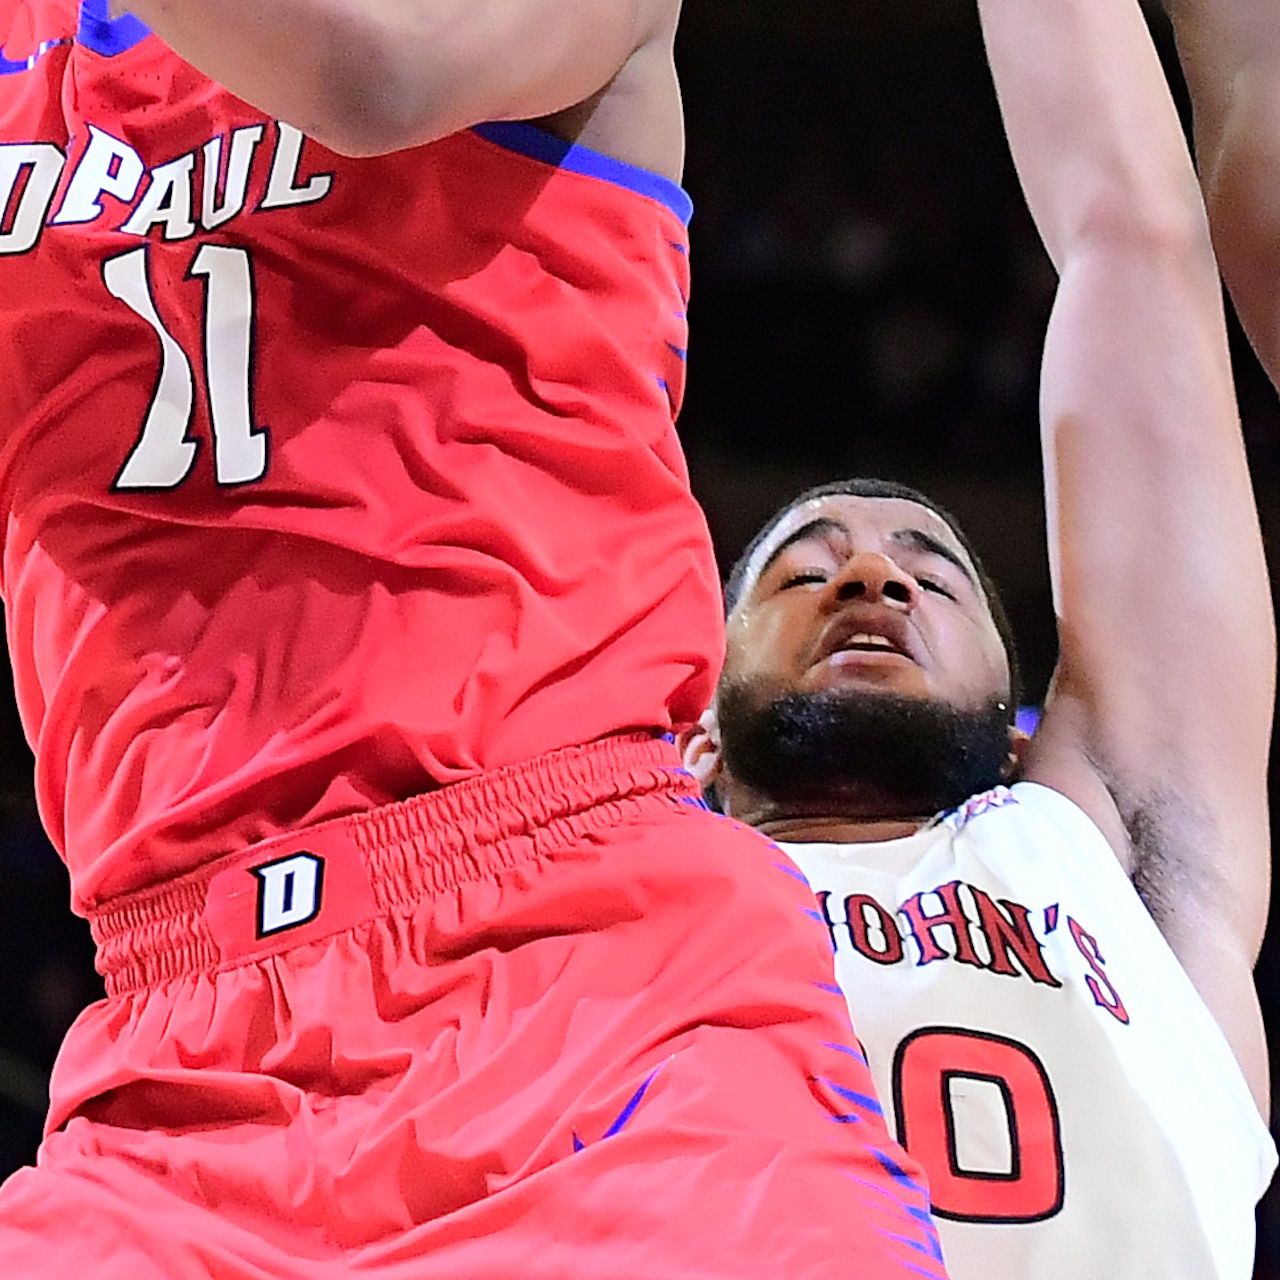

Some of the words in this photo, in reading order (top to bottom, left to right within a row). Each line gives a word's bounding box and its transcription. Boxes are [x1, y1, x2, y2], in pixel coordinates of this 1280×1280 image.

[102, 243, 270, 494] 11
[247, 851, 326, 942] D
[857, 1025, 1065, 1226] 0
